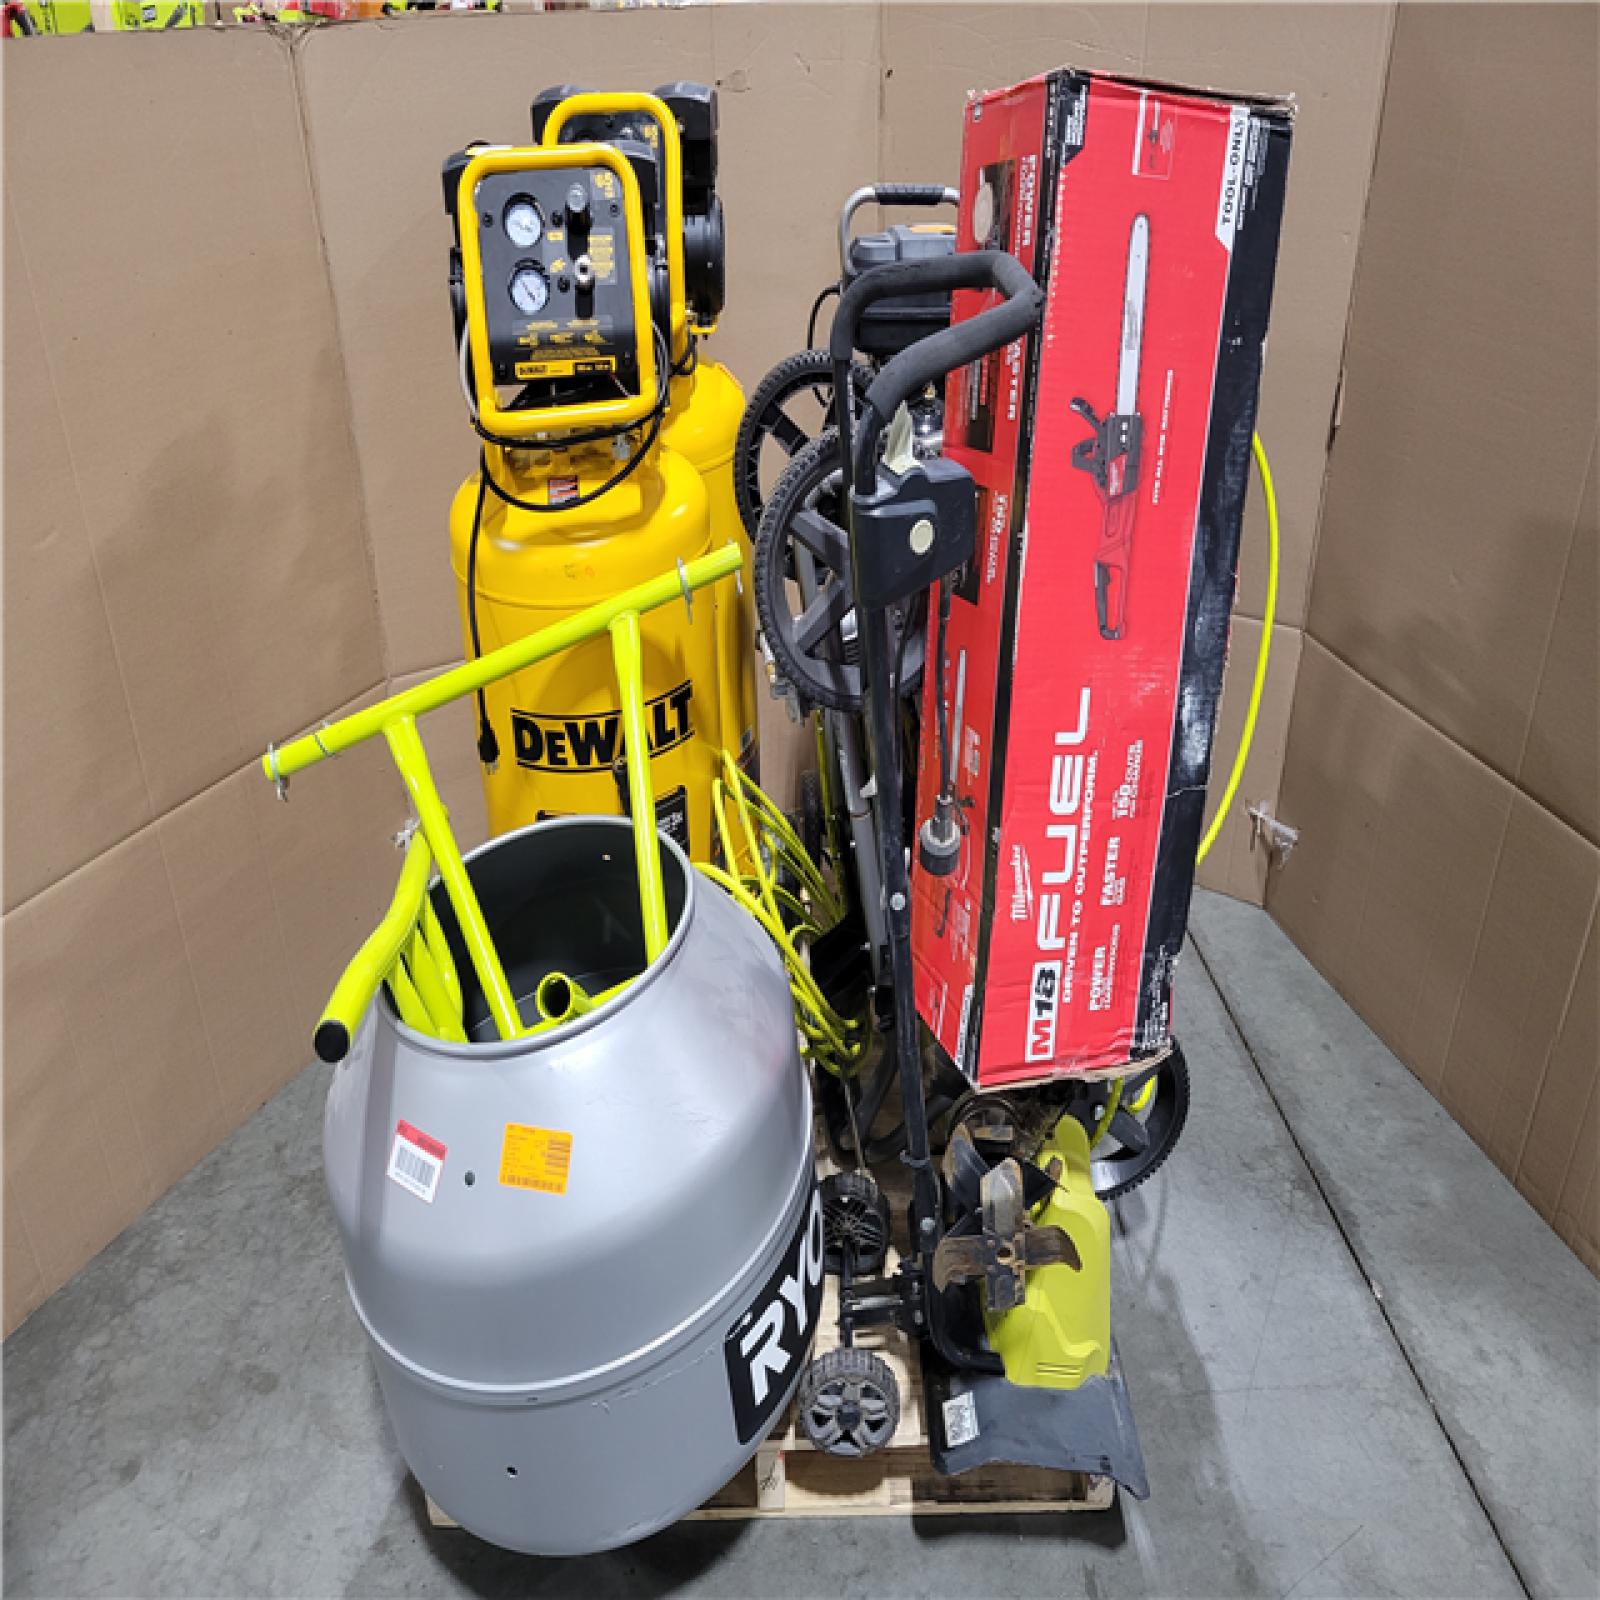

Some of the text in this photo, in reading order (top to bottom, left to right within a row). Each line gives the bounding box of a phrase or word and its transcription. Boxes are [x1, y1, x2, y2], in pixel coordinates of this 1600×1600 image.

[1222, 119, 1243, 226] TOOL-ONLY
[513, 687, 692, 766] DEWLT
[1010, 844, 1031, 921] Milwaukee
[1031, 687, 1091, 1056] M18 FUEL
[1100, 836, 1120, 906] FASTER
[1062, 931, 1078, 1003] DRIVEN
[1071, 900, 1082, 925] TO
[1089, 946, 1106, 1011] POWER
